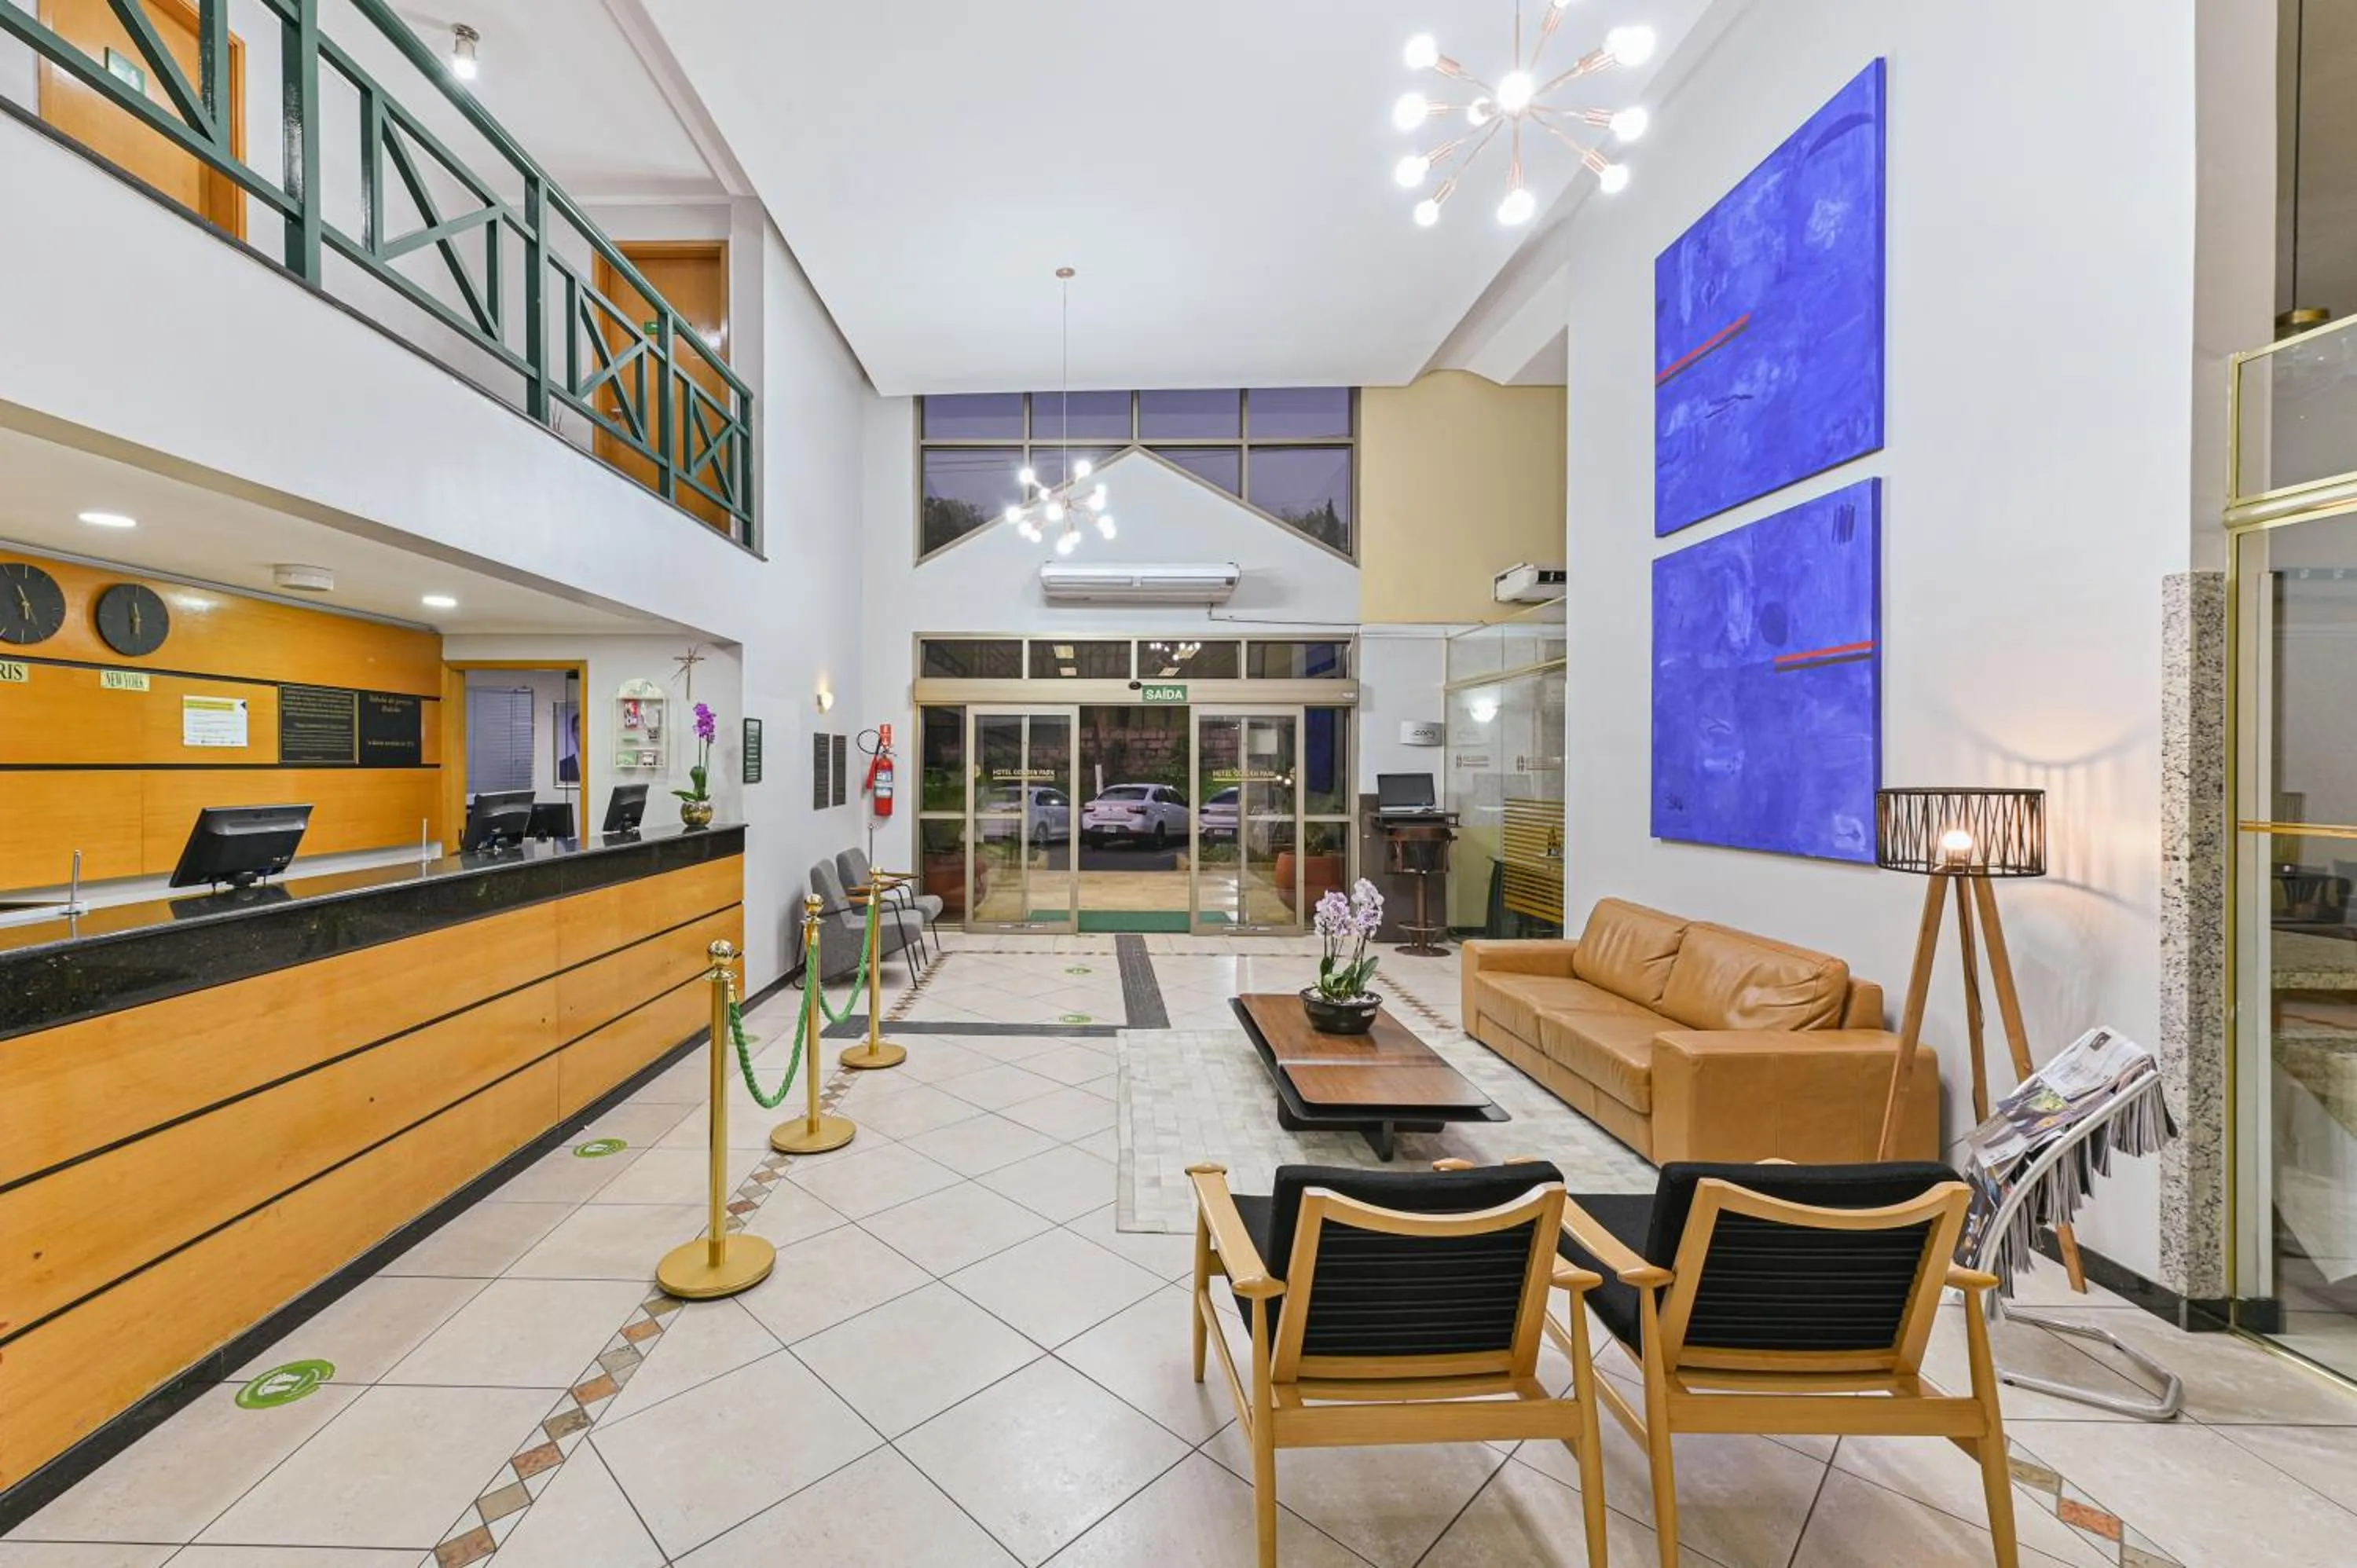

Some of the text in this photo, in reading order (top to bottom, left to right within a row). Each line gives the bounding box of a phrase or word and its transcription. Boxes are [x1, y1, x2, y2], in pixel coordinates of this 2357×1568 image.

[106, 672, 145, 689] NEW YORK
[1146, 686, 1183, 700] SAÍDA
